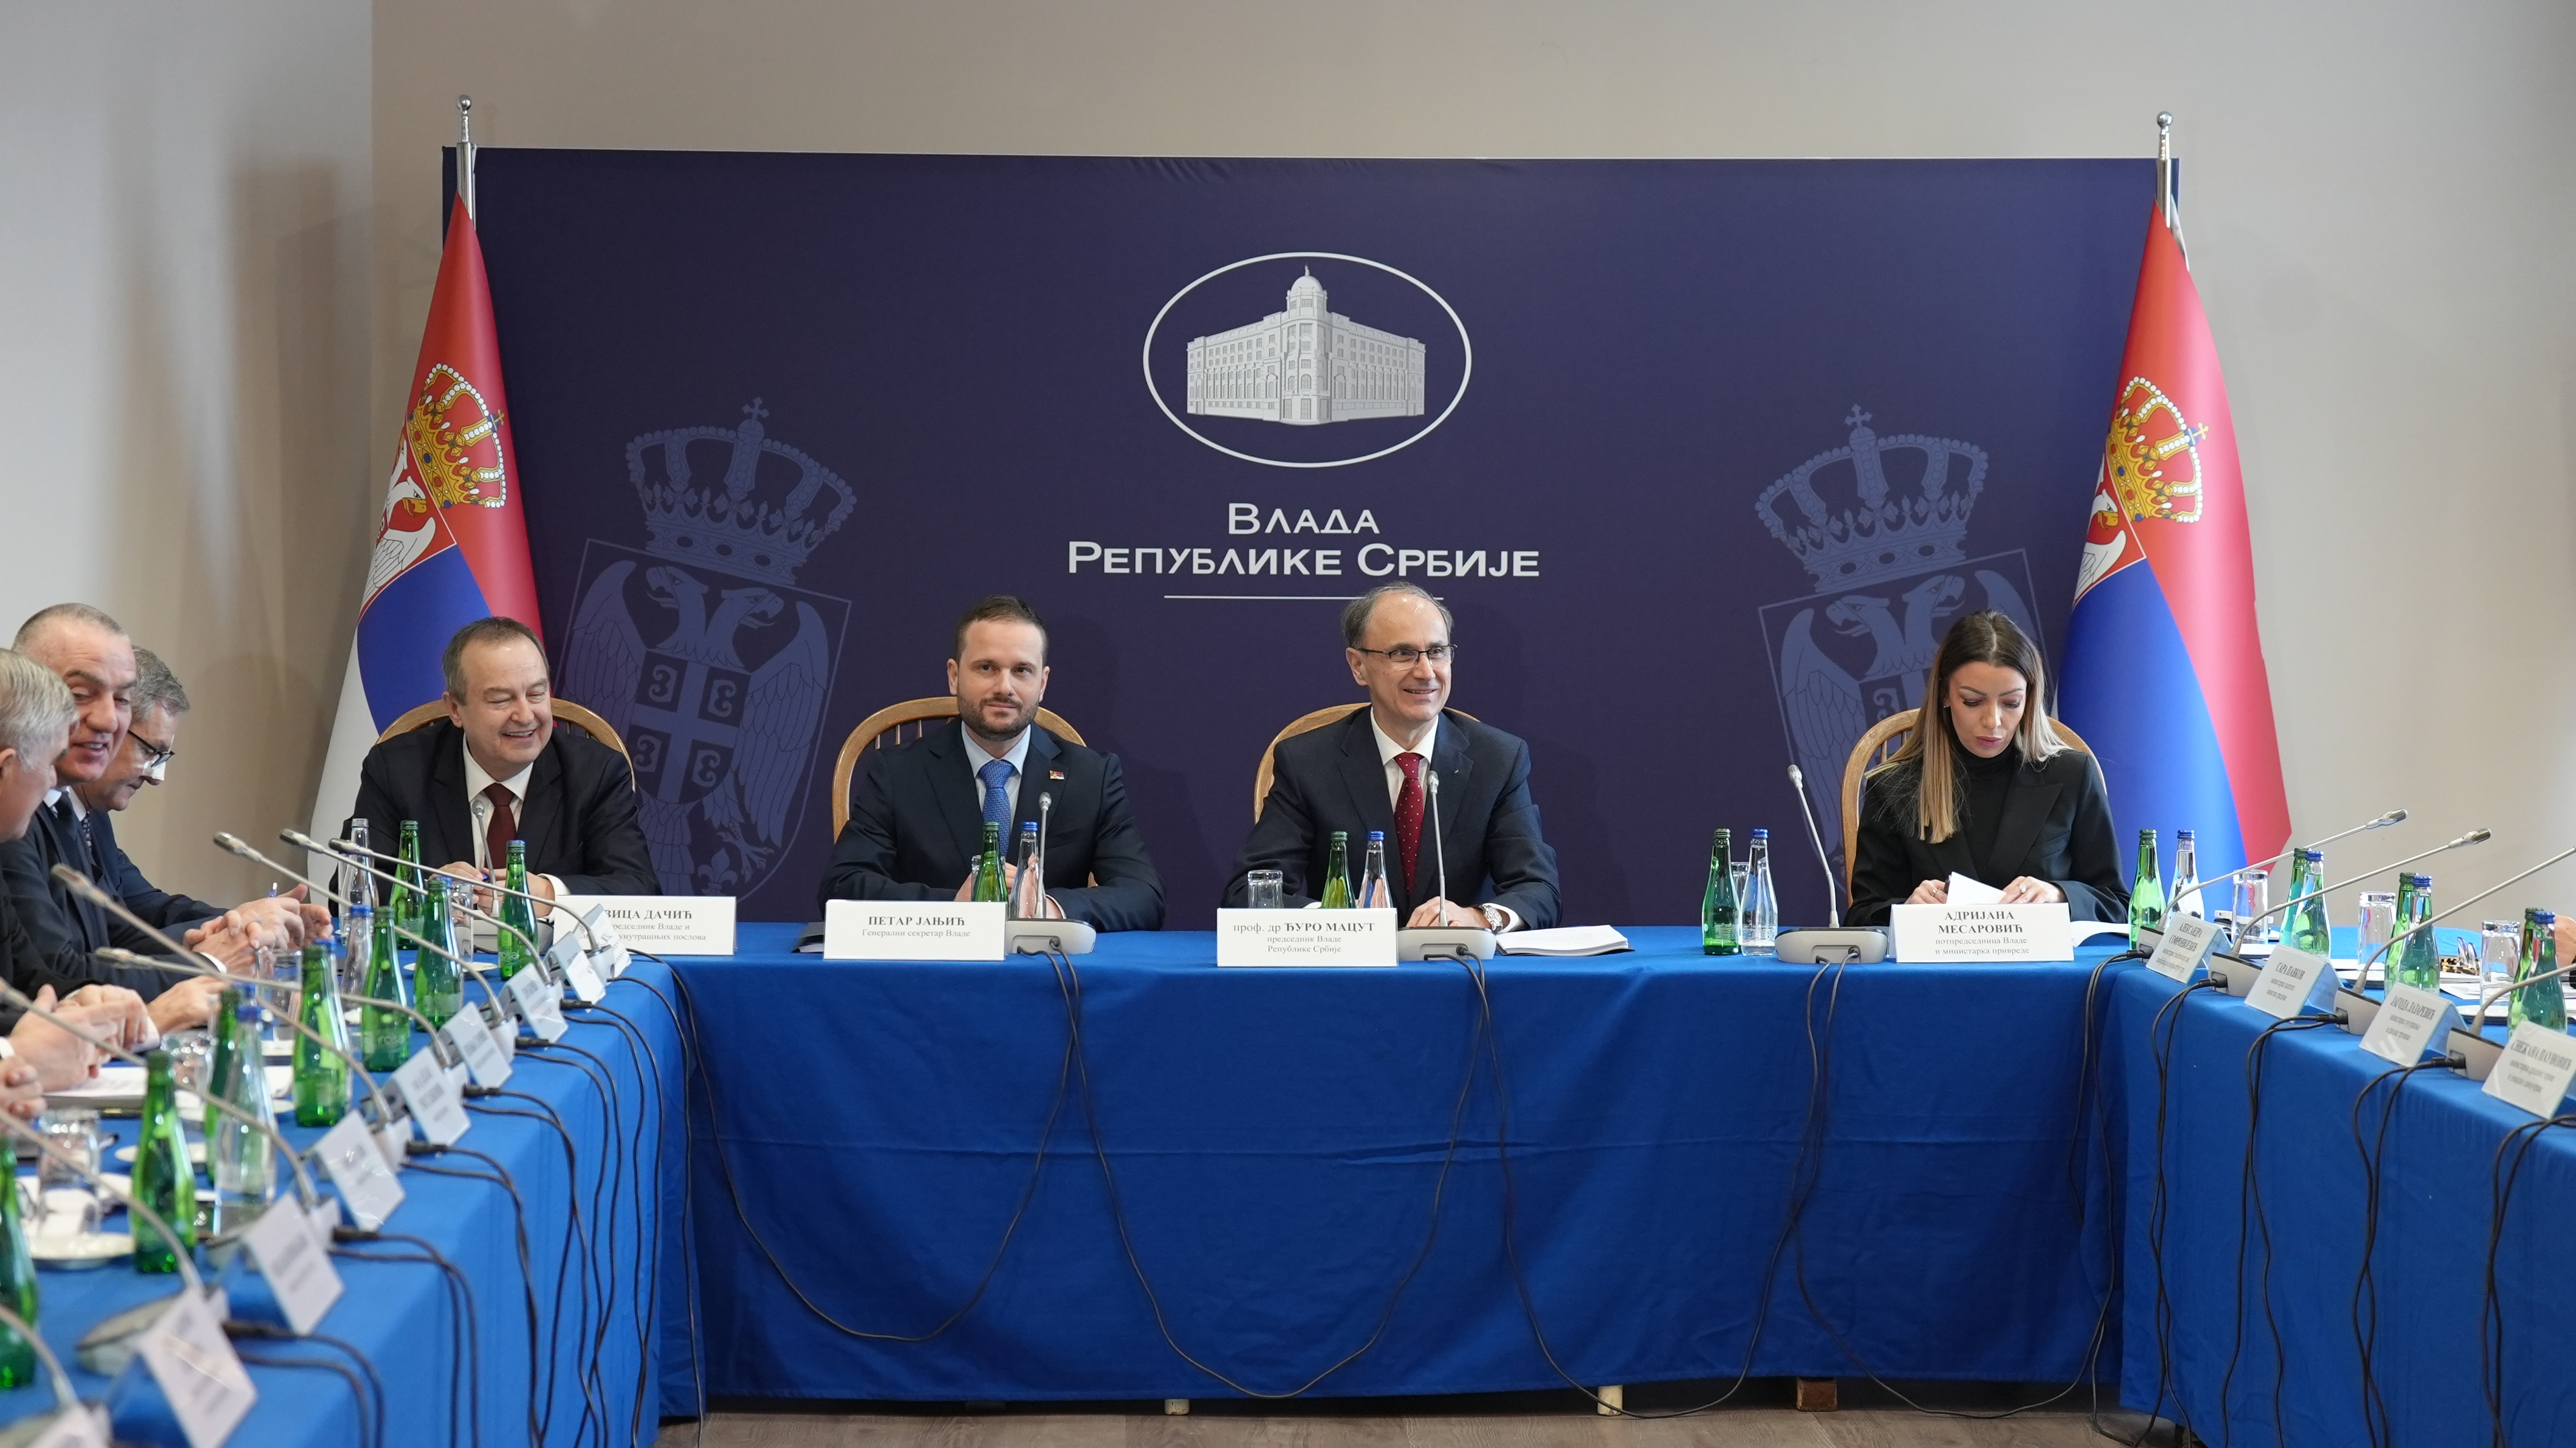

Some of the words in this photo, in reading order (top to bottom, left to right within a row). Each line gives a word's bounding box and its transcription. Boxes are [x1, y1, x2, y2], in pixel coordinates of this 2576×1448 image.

[606, 910, 640, 920] ВИЦА
[643, 910, 692, 920] ДАЧИЋ
[1945, 911, 2015, 921] АДРИЈАНА
[868, 917, 913, 925] ПЕТАР
[916, 917, 965, 926] ЈАЊИЋ
[1233, 923, 1264, 933] проф.
[1326, 923, 1375, 933] МАЦУТ
[1938, 924, 2023, 934] МЕСАРОВИЋ
[862, 929, 905, 938] Генерални
